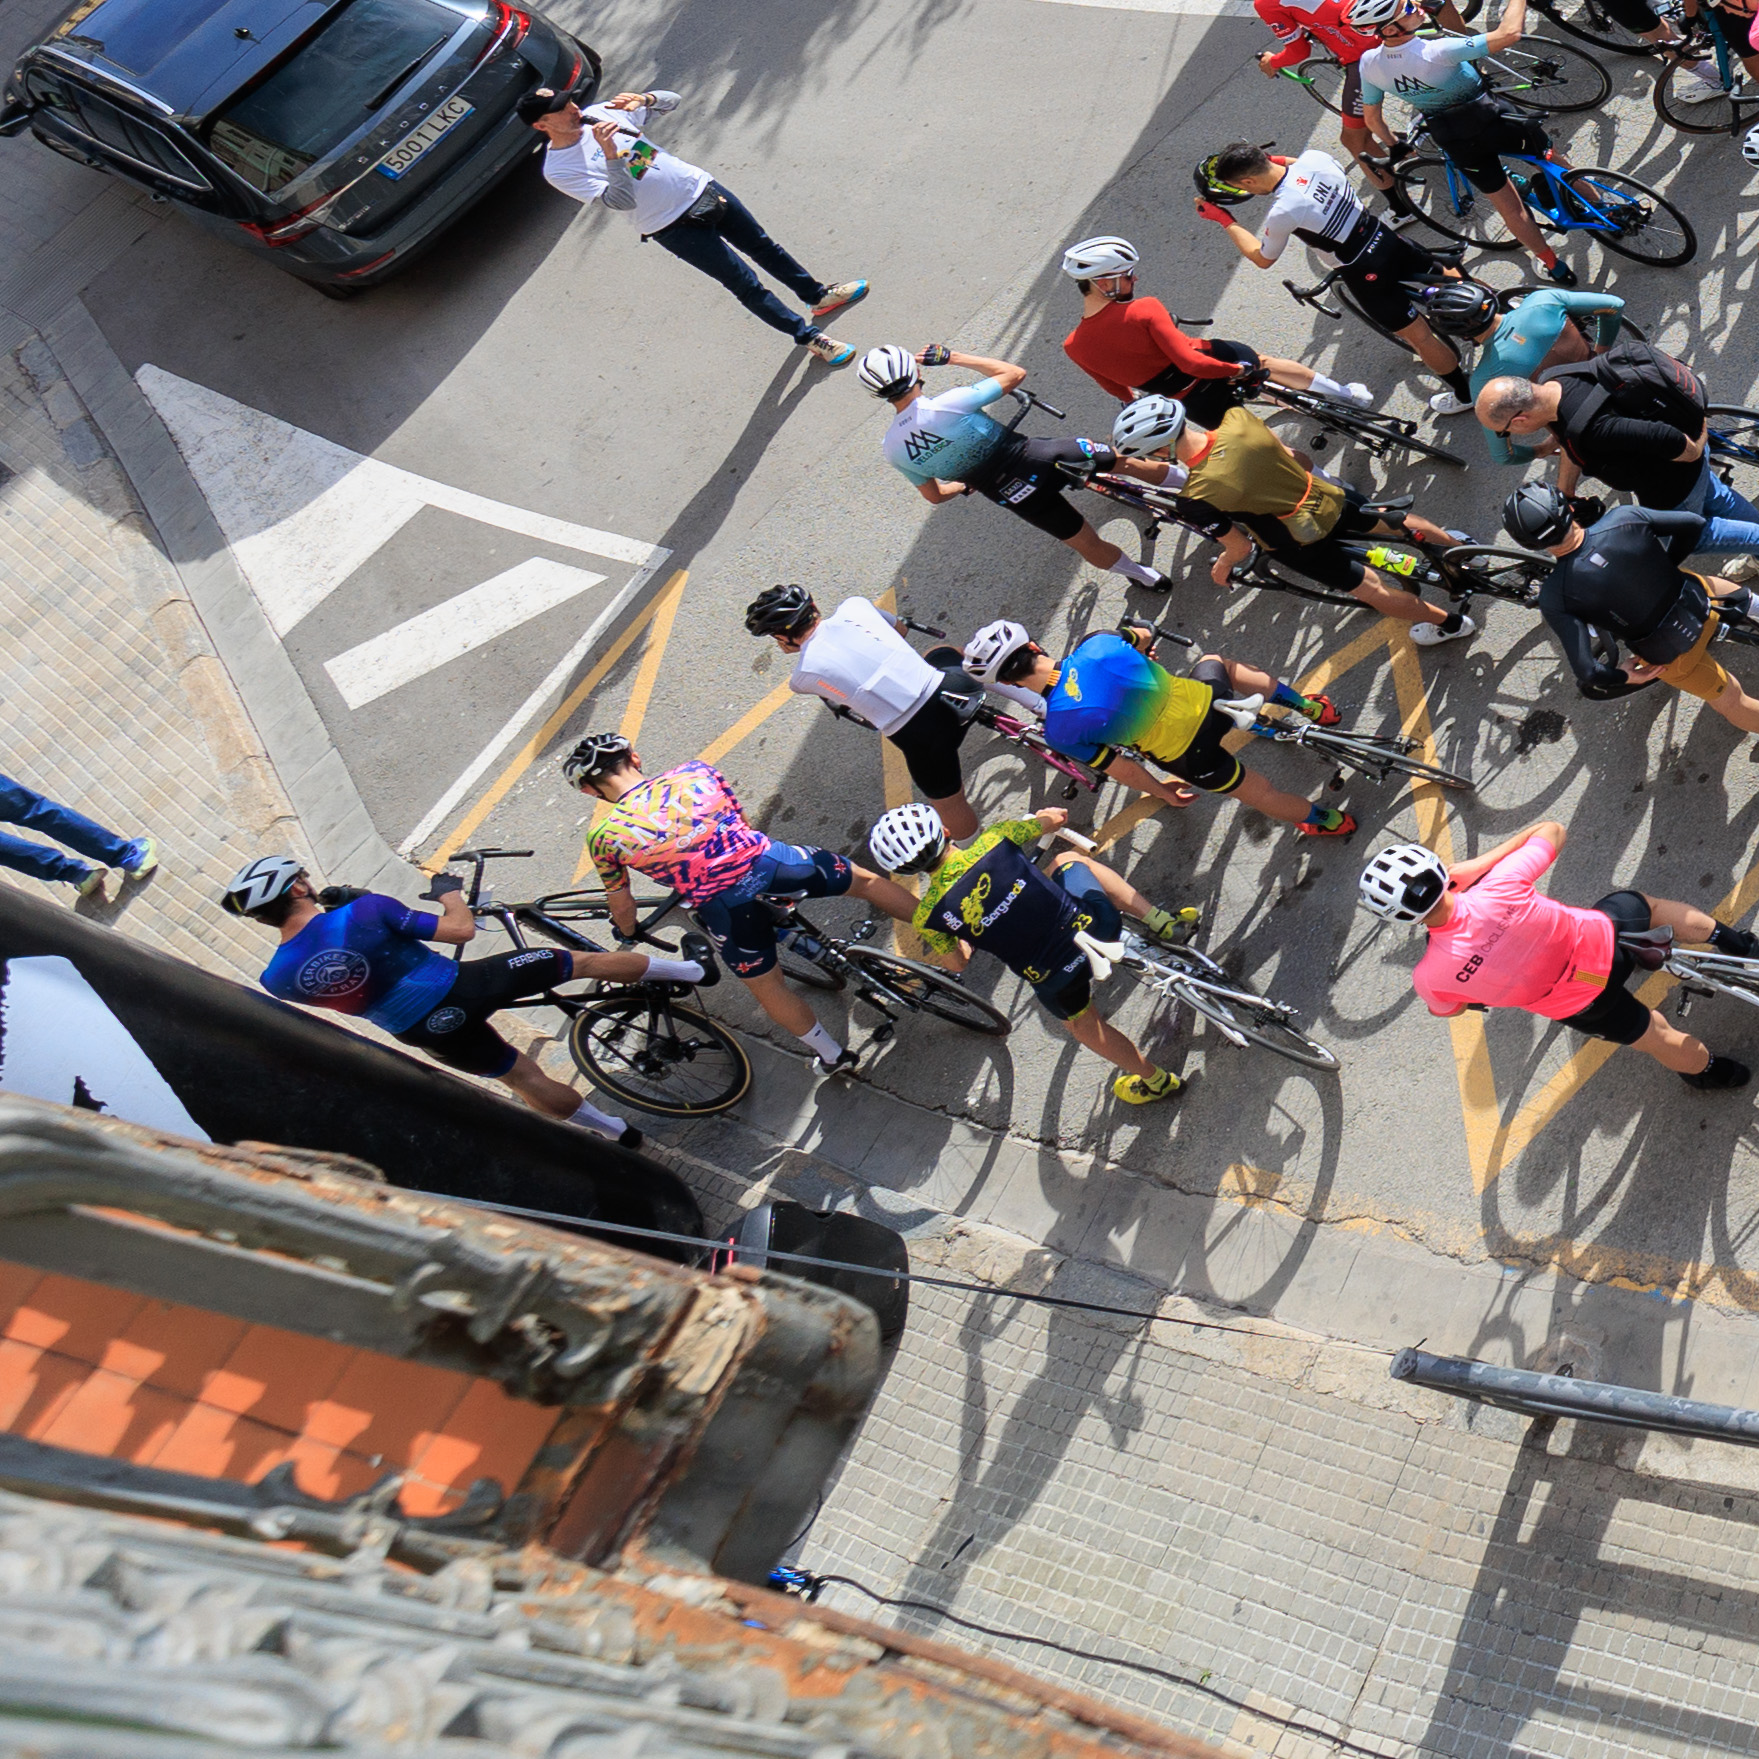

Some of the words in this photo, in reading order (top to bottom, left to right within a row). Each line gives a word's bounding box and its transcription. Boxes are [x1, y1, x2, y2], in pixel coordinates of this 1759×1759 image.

[386, 131, 431, 172] 5001
[432, 97, 468, 139] LKC
[1313, 182, 1333, 204] CNL
[943, 911, 963, 931] Bike
[1072, 913, 1093, 932] 23
[1456, 951, 1485, 984] CEB
[1482, 903, 1519, 954] CICLISME
[300, 952, 348, 988] FERBIKES
[508, 947, 554, 971] FERBIKES
[1063, 952, 1088, 973] Bergu
[1024, 965, 1039, 982] 15
